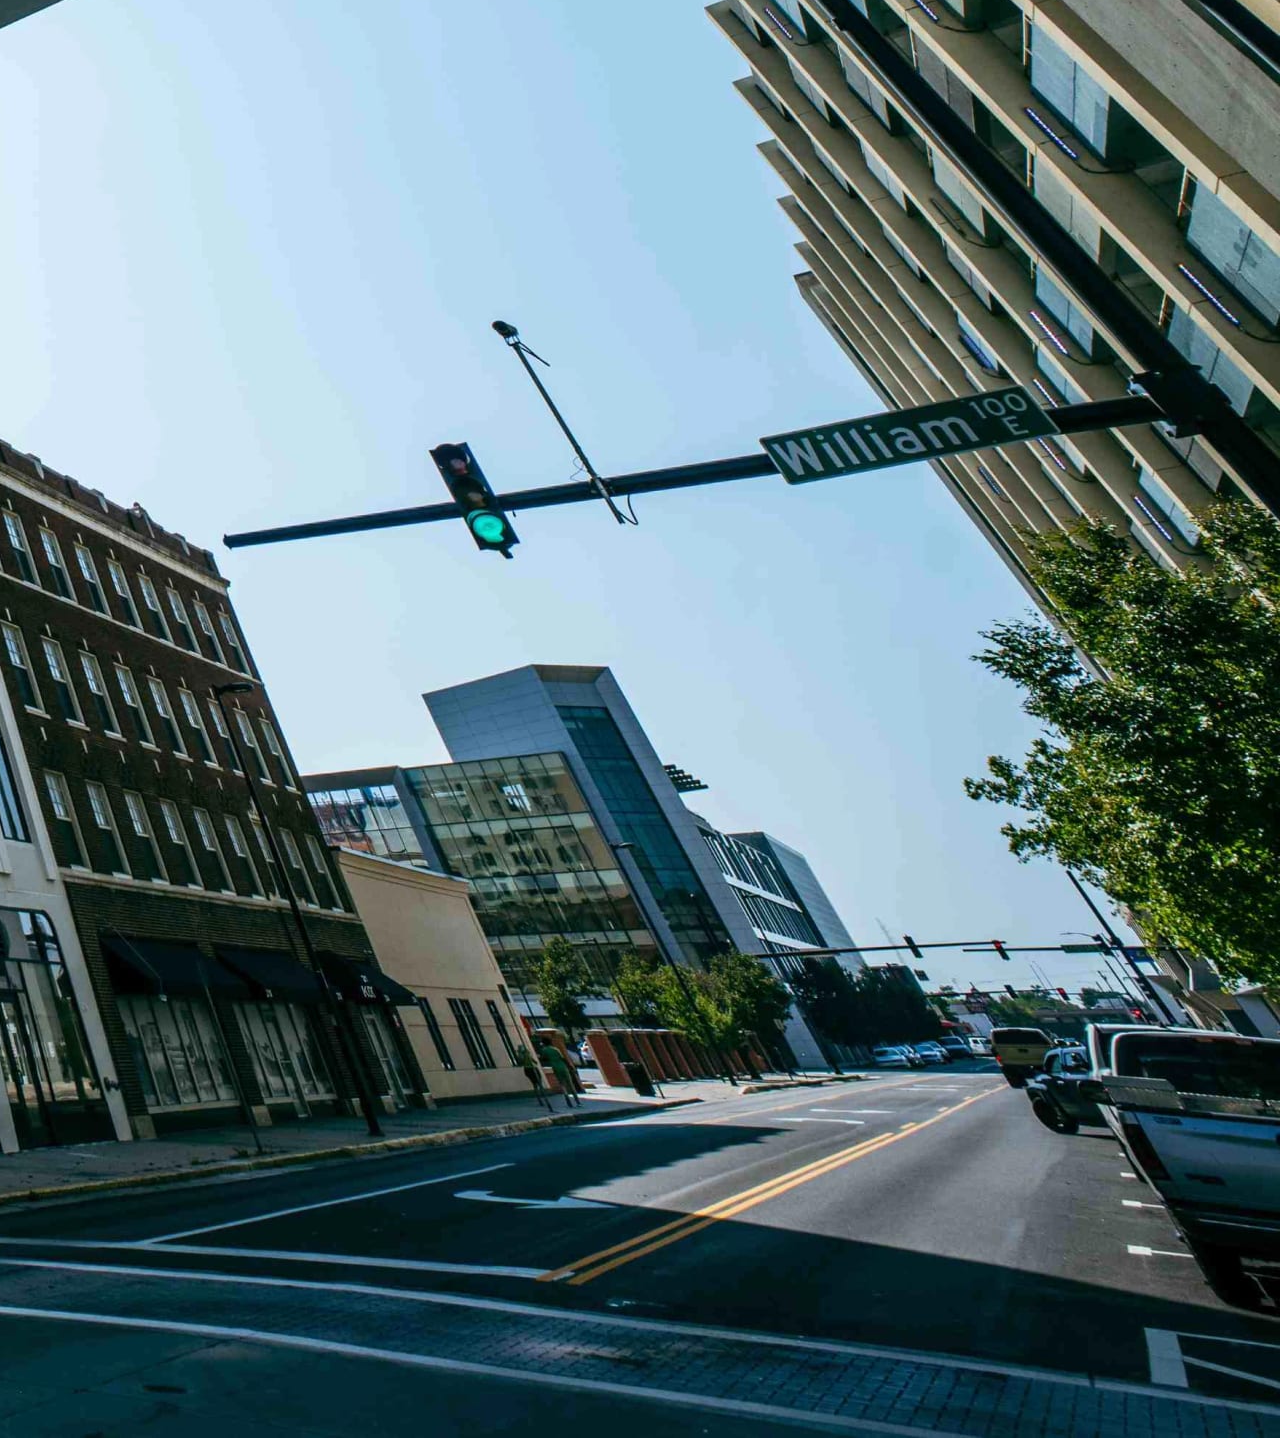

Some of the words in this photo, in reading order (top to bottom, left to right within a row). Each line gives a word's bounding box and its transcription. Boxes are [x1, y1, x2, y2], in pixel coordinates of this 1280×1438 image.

[771, 416, 979, 476] William
[969, 393, 1028, 420] 100
[1001, 415, 1029, 436] E
